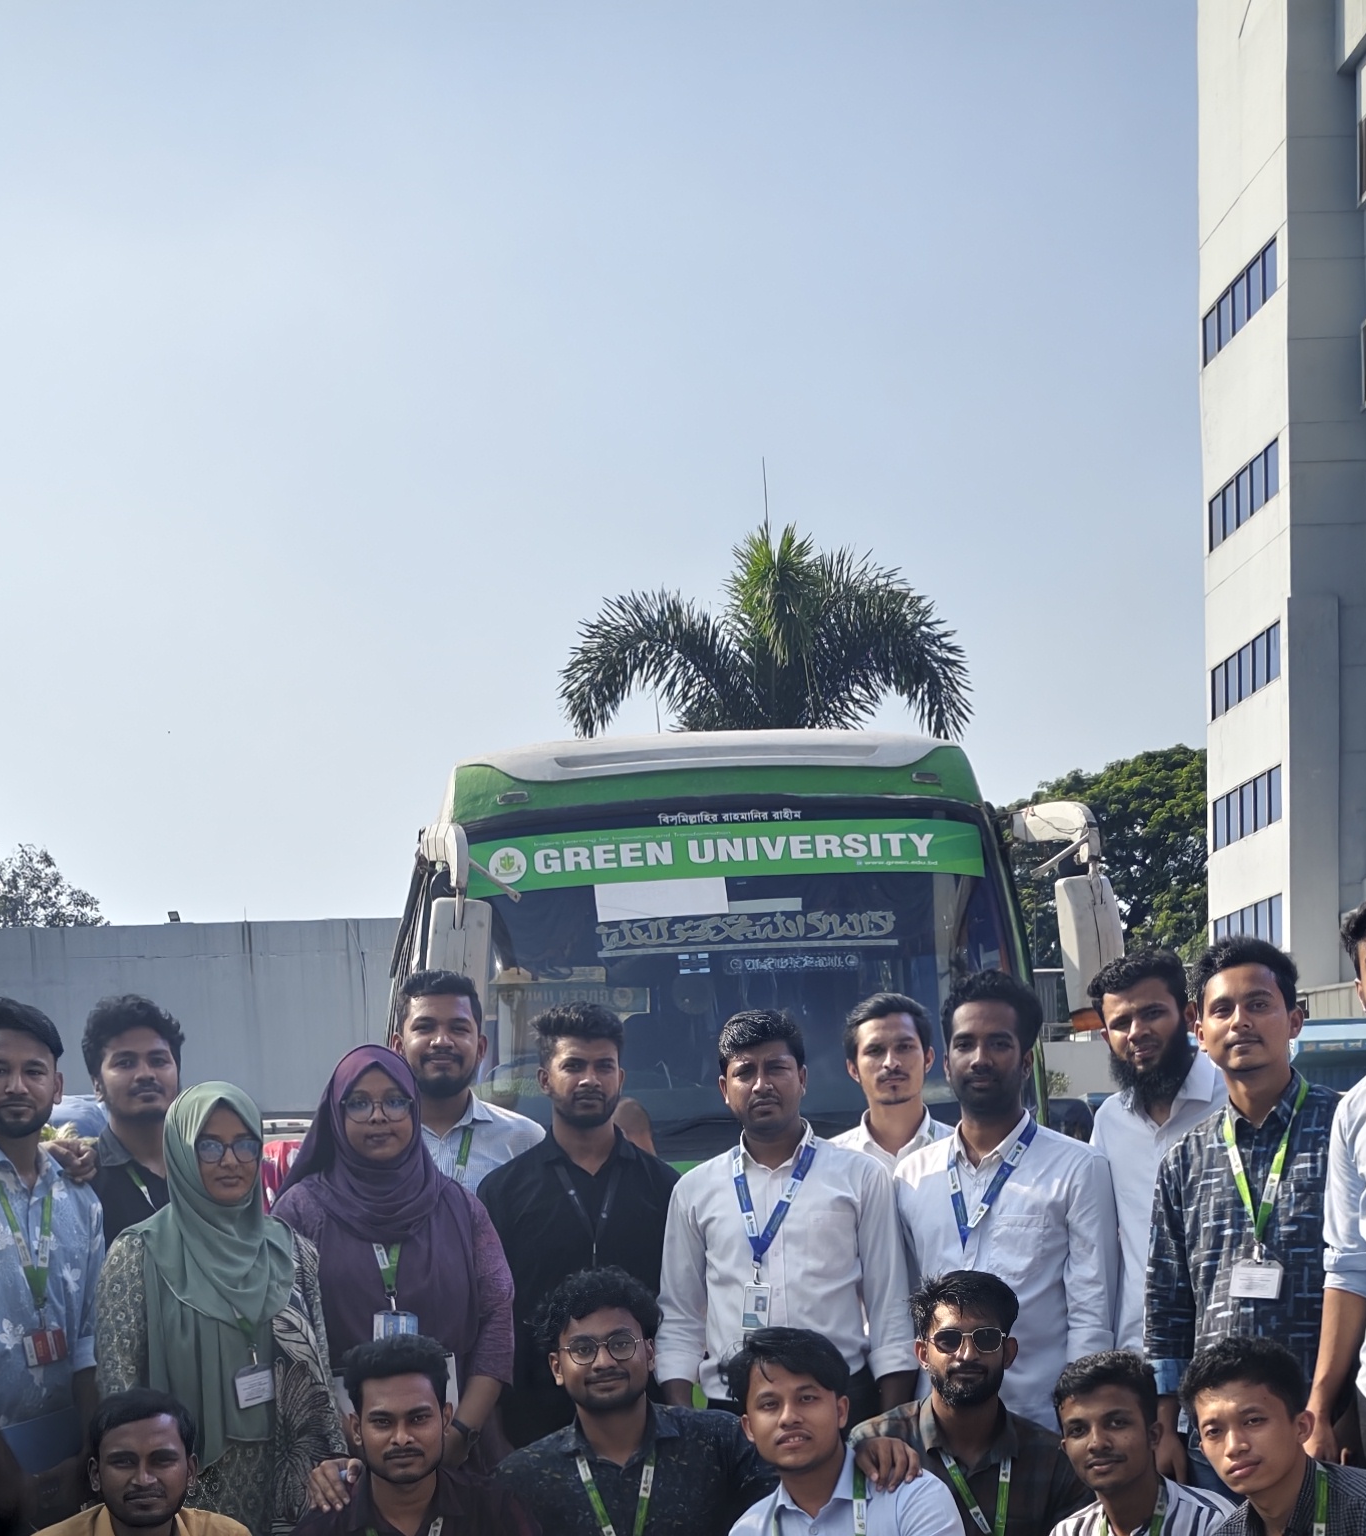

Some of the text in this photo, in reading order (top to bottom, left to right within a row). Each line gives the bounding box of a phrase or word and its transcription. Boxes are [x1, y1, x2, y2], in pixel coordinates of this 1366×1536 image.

[722, 809, 769, 822] রাহমানির
[771, 808, 801, 821] রাহীম
[533, 833, 934, 875] GREEN UNIVERSITY
